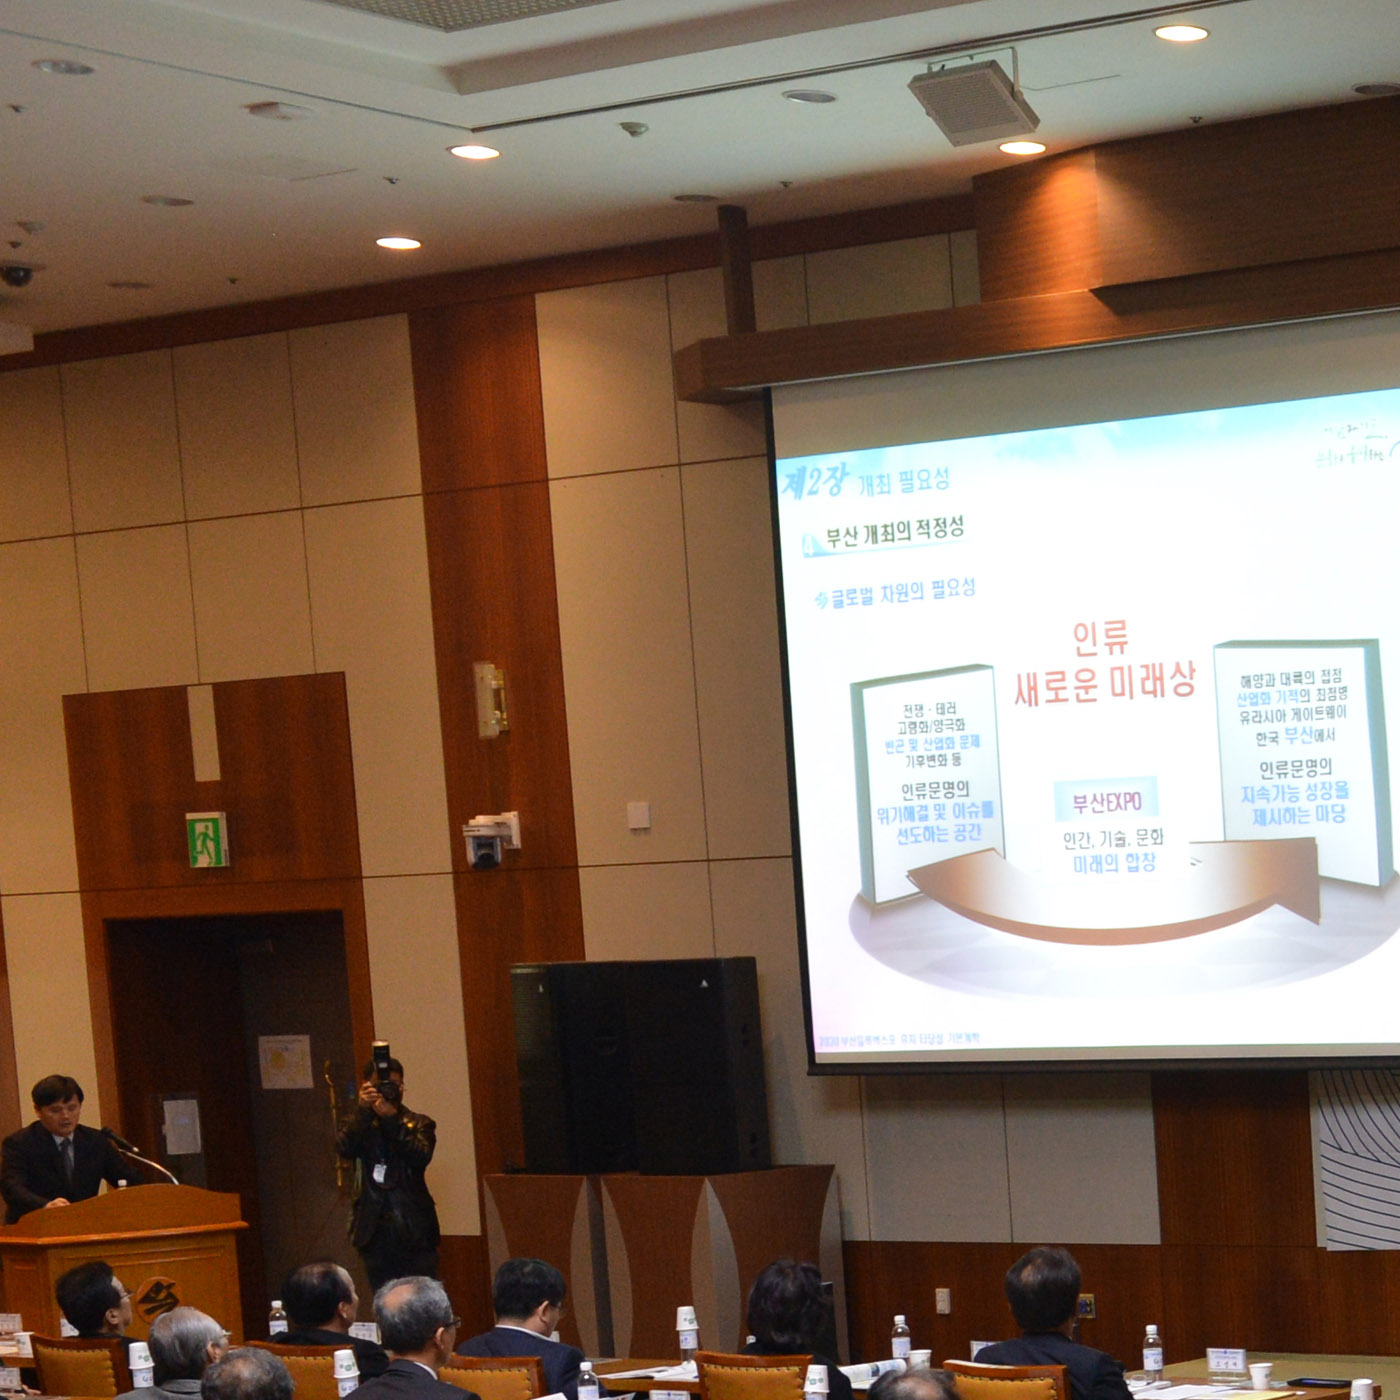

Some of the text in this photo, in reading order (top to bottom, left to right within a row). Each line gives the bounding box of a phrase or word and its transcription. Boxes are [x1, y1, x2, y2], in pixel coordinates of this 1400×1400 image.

[781, 461, 950, 500] 제2장 개최 필요성
[827, 526, 858, 548] 부산
[864, 520, 912, 545] 개최의
[916, 515, 965, 539] 적정성
[832, 577, 976, 609] 글로벌 차원의 필요성
[1073, 618, 1129, 658] 인류
[1014, 660, 1197, 708] 새로운 미래상
[1240, 704, 1347, 726] 유라시아 게이트웨이
[1256, 731, 1279, 747] 한국
[1260, 757, 1332, 780] 인류문명의
[901, 780, 970, 801] 인류문명의
[1241, 780, 1349, 804] 지속가능 성장을
[877, 804, 929, 825] 위기해결
[1073, 792, 1142, 814] 부산EXPO
[1252, 804, 1346, 827] 제시하는 마당
[953, 823, 983, 842] 공간
[1063, 832, 1095, 851] 인간,
[1136, 827, 1165, 847] 문화
[1073, 852, 1156, 875] 미래의 합창
